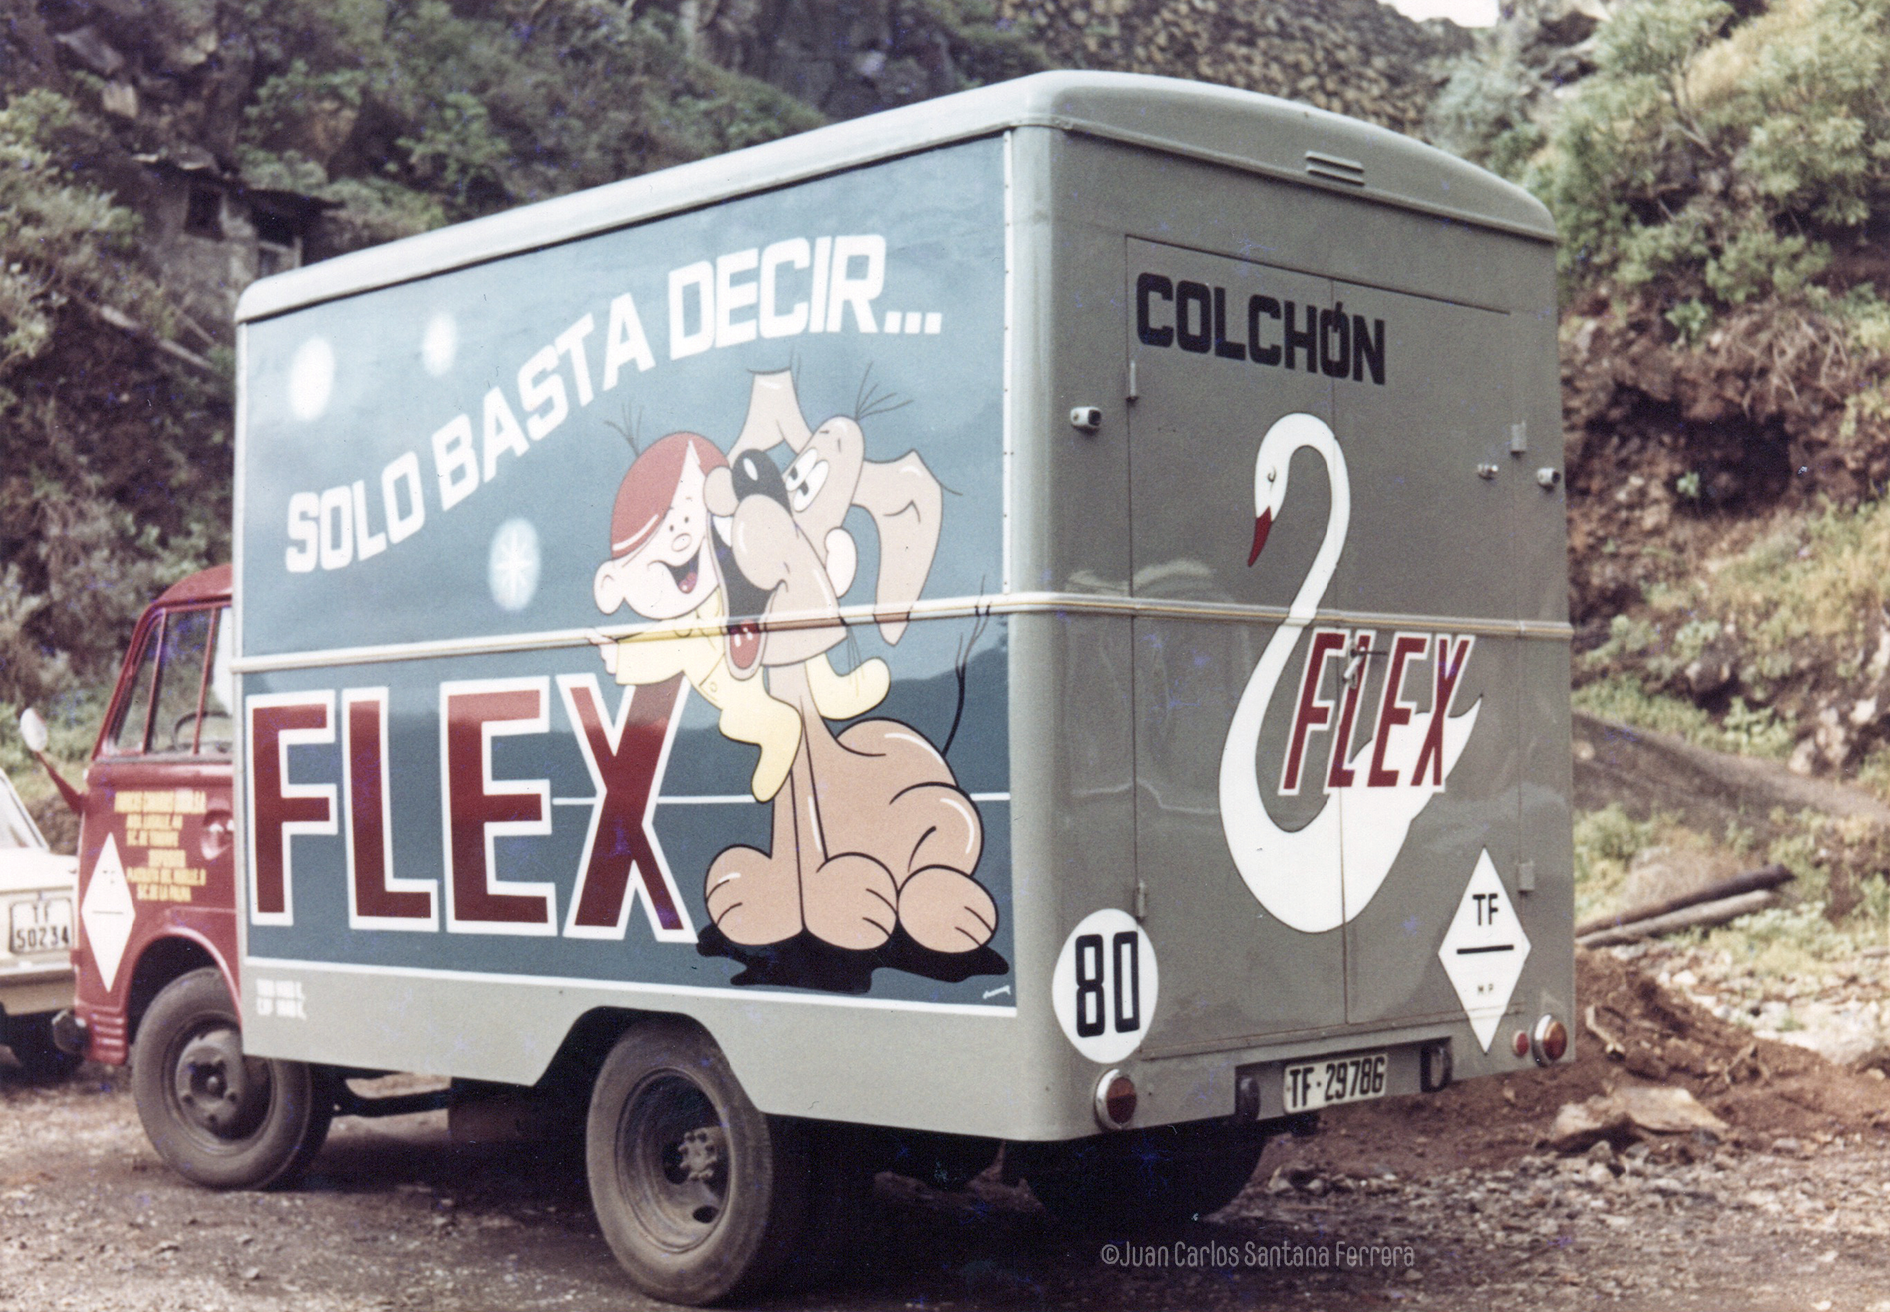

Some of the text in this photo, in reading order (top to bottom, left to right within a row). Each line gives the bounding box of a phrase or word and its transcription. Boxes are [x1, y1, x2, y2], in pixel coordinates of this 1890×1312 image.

[1136, 272, 1387, 385] COLCHÓN
[285, 234, 942, 573] SOLO BASTA DECIR...
[1278, 627, 1475, 796] FLEX
[245, 673, 698, 943] FLEX
[1472, 893, 1499, 926] TF
[1075, 930, 1140, 1037] 80
